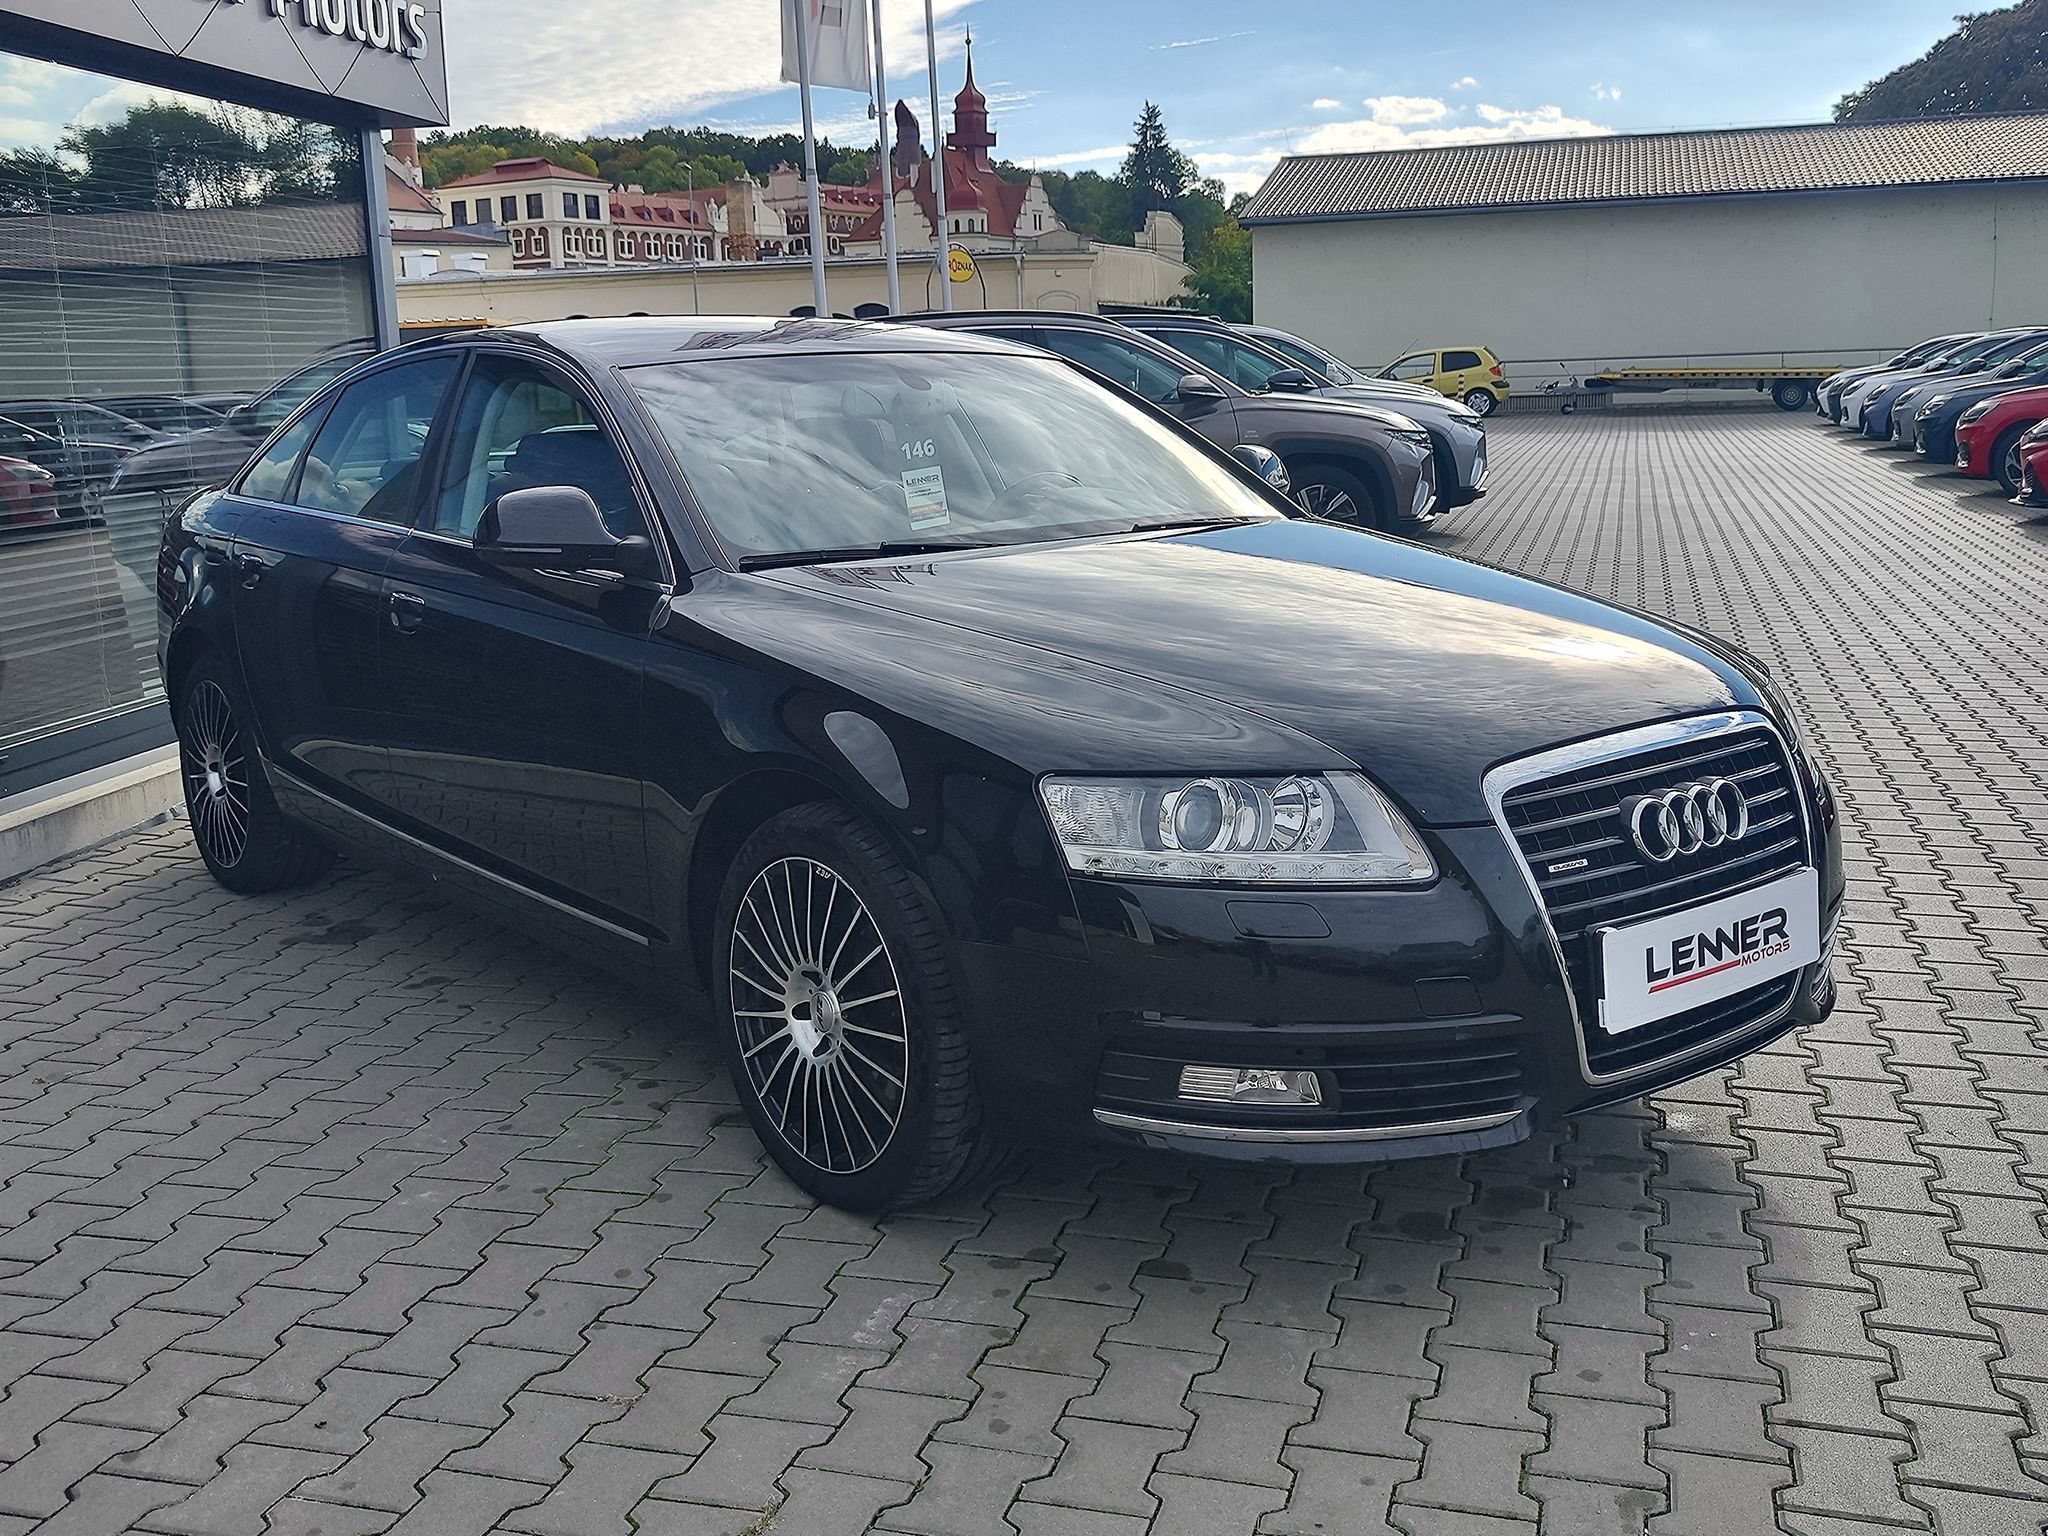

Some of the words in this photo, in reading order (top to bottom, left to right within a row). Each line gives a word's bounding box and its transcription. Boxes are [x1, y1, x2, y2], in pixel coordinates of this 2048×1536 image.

[901, 439, 935, 460] 146
[906, 475, 940, 486] LENNER
[1646, 907, 1790, 983] LENNER
[1741, 940, 1791, 966] MOTORS
